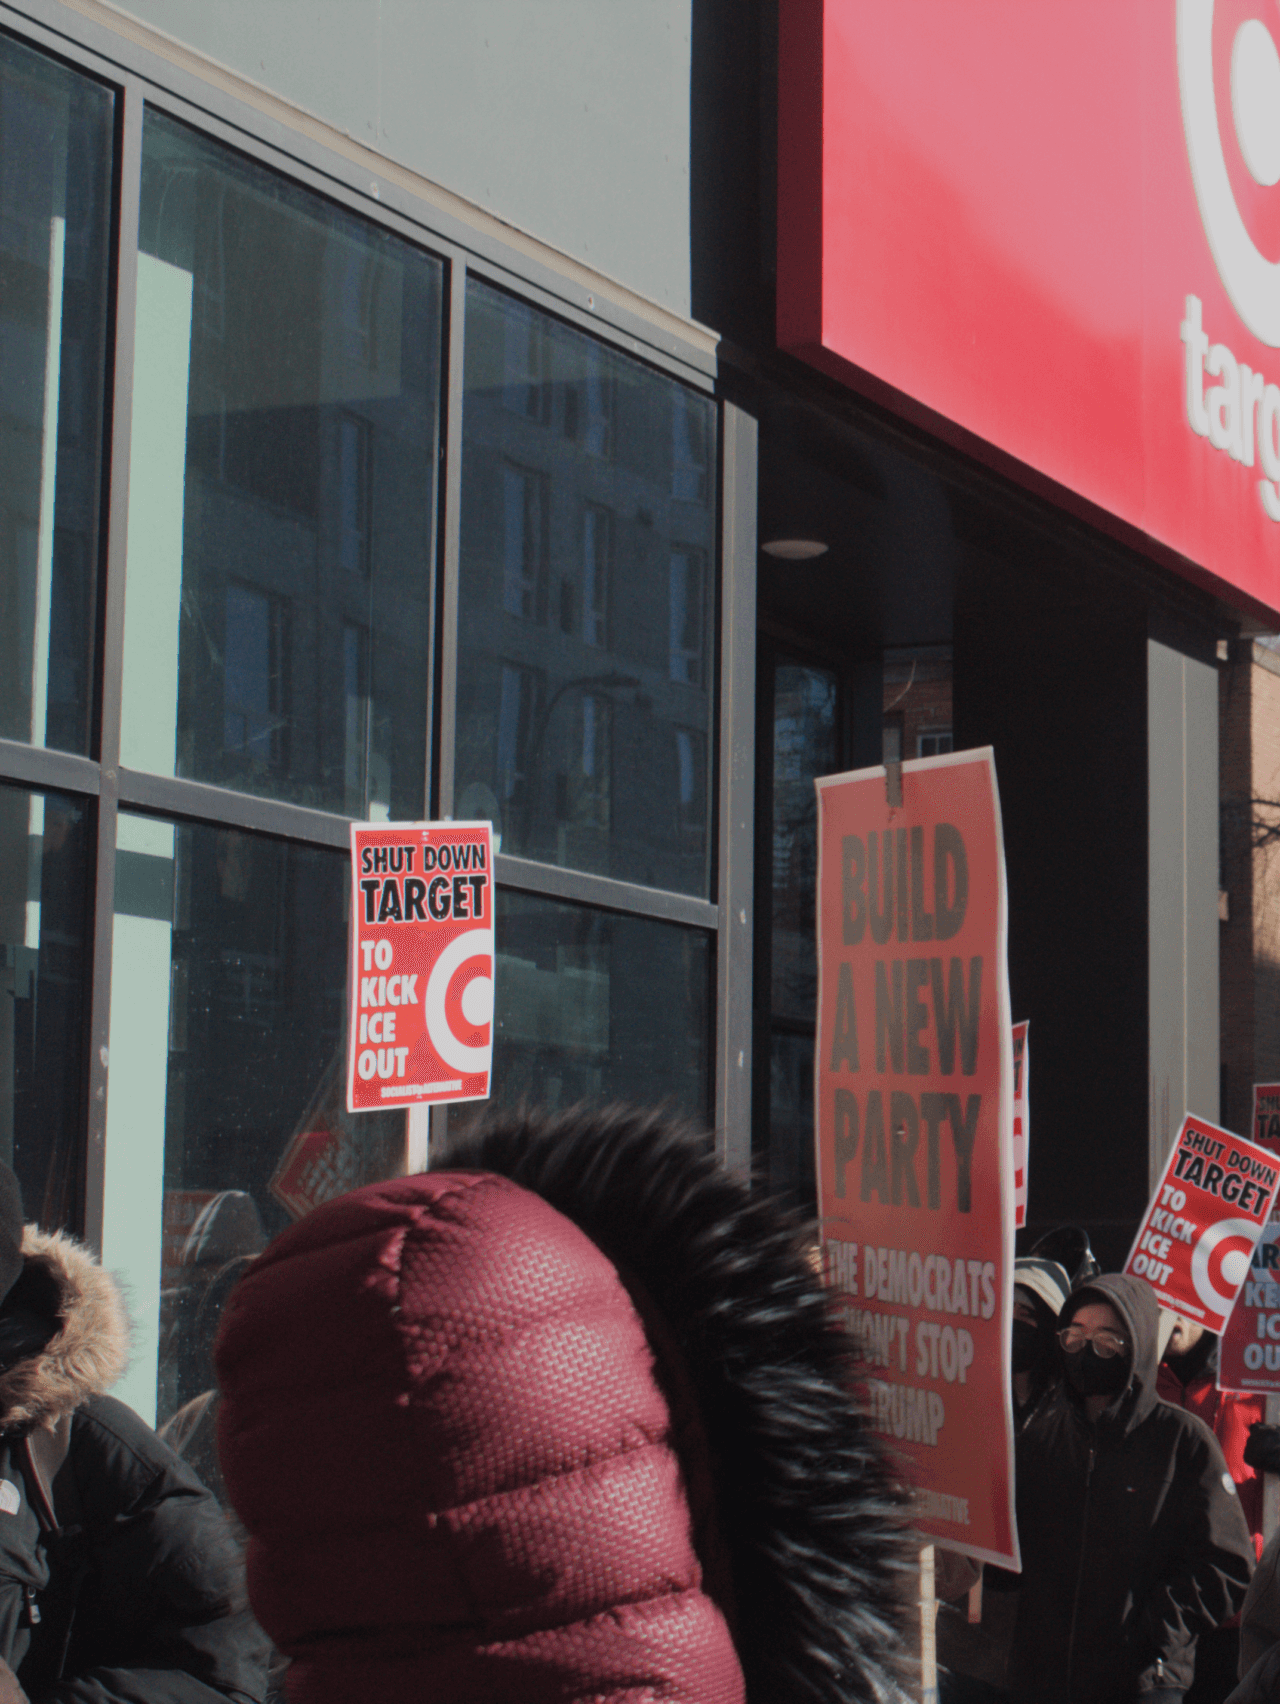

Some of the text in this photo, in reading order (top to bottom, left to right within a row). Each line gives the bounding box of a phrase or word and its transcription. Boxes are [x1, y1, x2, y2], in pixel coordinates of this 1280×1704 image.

[361, 844, 485, 873] SHUT DOWN
[361, 875, 487, 923] TARGET
[841, 823, 969, 946] BUILD
[361, 939, 393, 971] TO
[360, 974, 418, 1008] KICK
[360, 1012, 396, 1044] ICE
[830, 962, 860, 1073] A
[875, 955, 984, 1076] NEW
[358, 1047, 408, 1080] OUT
[834, 1088, 982, 1213] PARTY
[1183, 1129, 1226, 1161] SHUT
[1227, 1150, 1277, 1188] DOWN
[1160, 1183, 1186, 1212] TO
[1171, 1148, 1270, 1217] TARGET
[1149, 1208, 1197, 1244] KICK
[1139, 1230, 1172, 1260] ICE
[827, 1239, 996, 1321] THE DEMOCRATS
[1132, 1254, 1174, 1287] OUT
[916, 1321, 974, 1384] STOP
